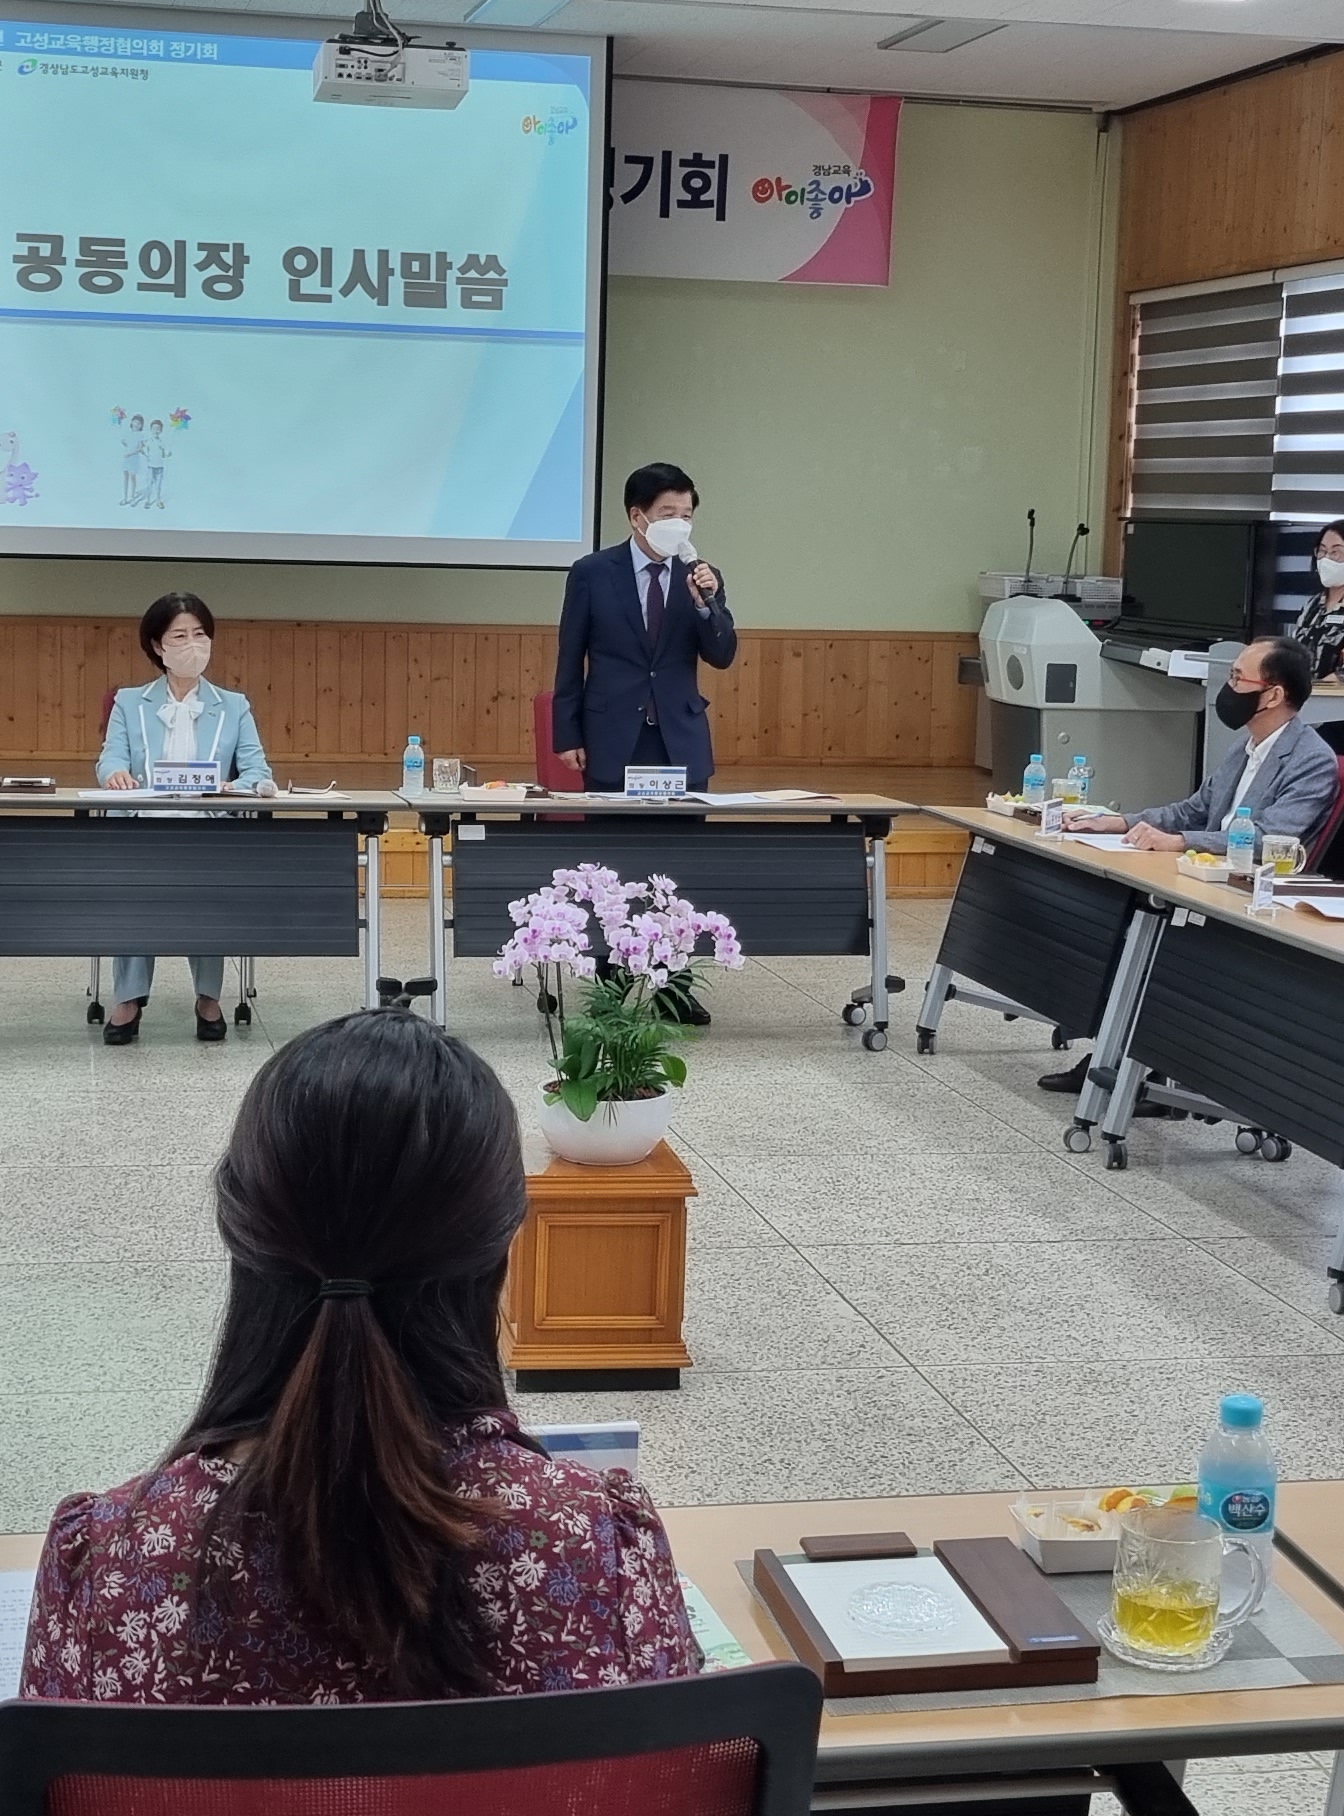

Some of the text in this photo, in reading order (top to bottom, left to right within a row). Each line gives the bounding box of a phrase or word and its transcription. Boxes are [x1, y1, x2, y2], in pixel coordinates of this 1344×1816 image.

[14, 31, 164, 57] 고성교육행정협의회
[169, 40, 218, 61] 정기회
[39, 61, 149, 81] 경상남도고성교육지원청
[609, 147, 729, 222] 기회
[811, 164, 852, 177] 경남교육
[751, 176, 873, 220] 아이좋아
[11, 231, 509, 311] 공동의장 인사말씀
[1227, 1503, 1266, 1518] 백산수
